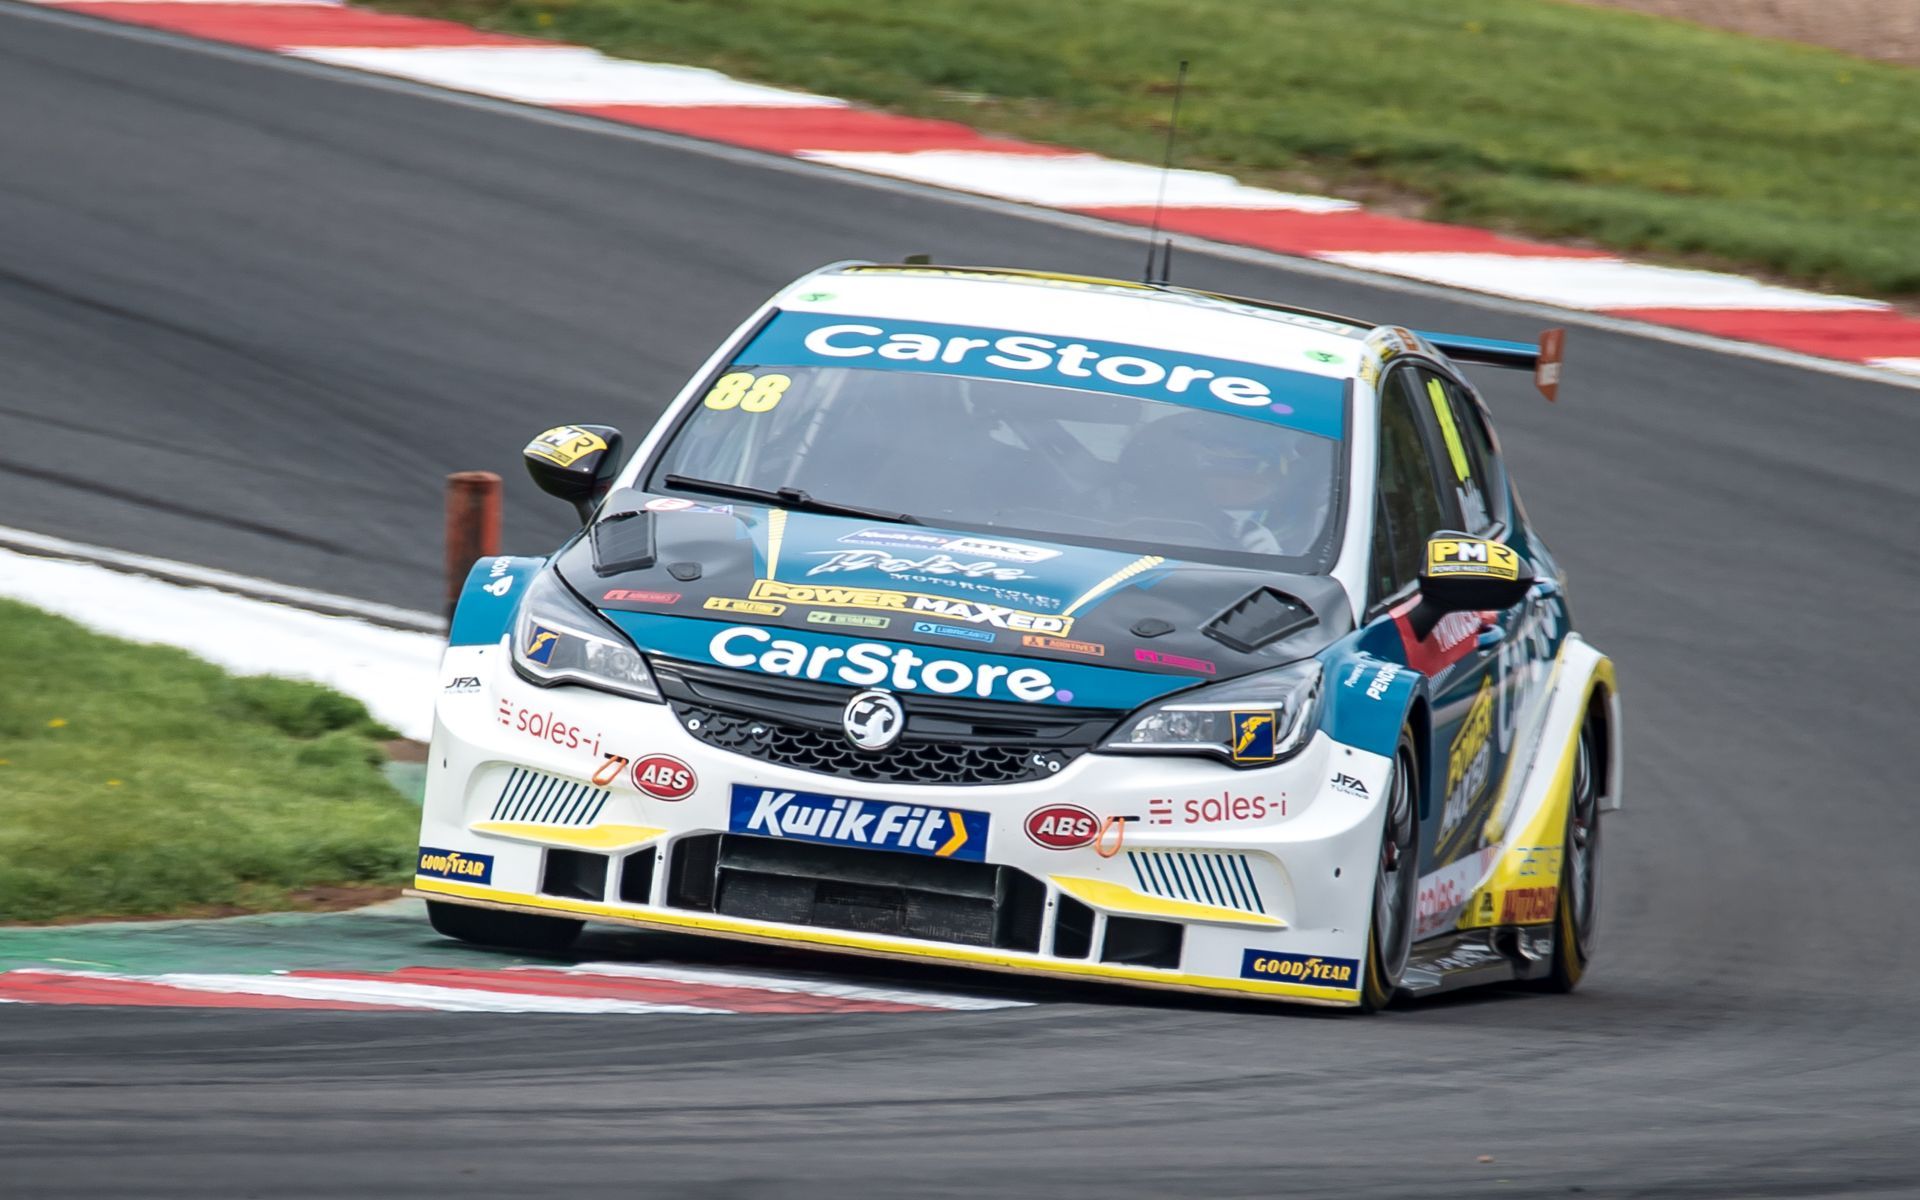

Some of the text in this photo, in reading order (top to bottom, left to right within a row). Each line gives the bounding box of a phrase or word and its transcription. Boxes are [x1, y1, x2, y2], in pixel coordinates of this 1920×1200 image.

[704, 371, 792, 414] 88
[758, 587, 1063, 633] POWER MAXED
[445, 676, 482, 689] JFA
[516, 708, 602, 757] sales-i
[640, 764, 690, 790] ABS
[1330, 772, 1369, 794] JFA
[1184, 791, 1287, 824] sales-i
[1036, 816, 1093, 838] ABS
[1253, 956, 1353, 983] GOODYEAR
